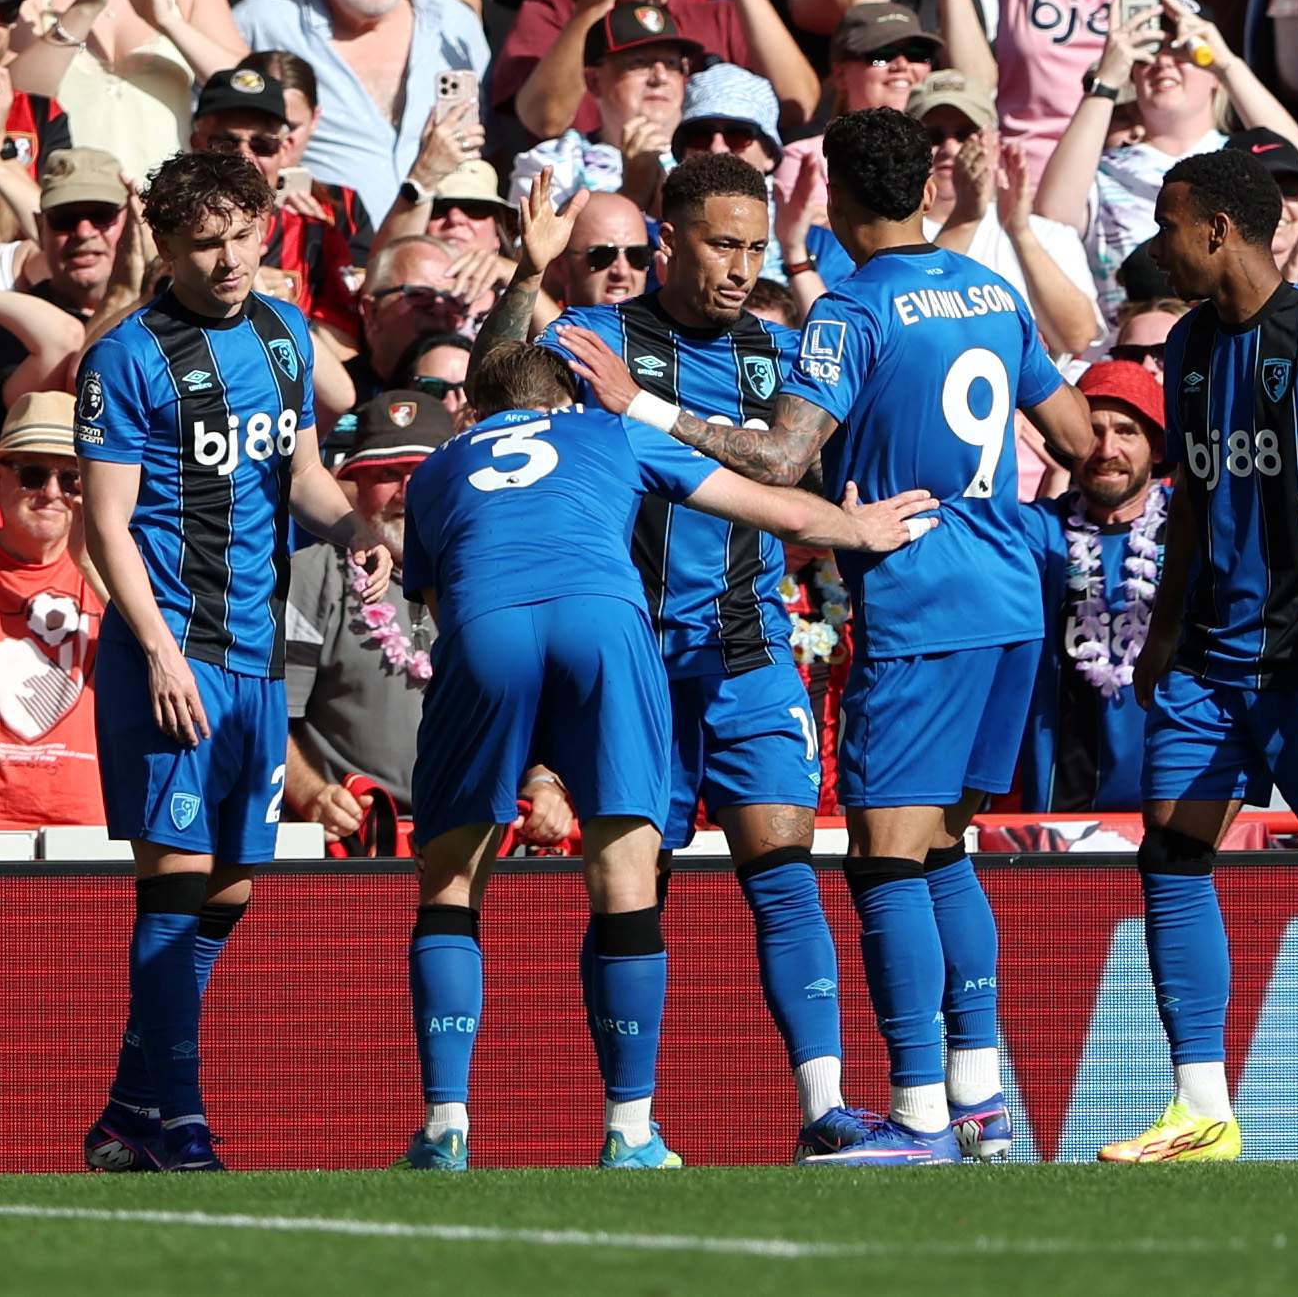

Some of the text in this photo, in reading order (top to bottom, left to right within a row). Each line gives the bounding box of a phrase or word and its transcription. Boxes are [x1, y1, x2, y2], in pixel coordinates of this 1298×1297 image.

[894, 284, 1016, 326] EVANILSON
[193, 409, 296, 475] bj88
[942, 348, 1008, 498] 9
[469, 419, 559, 492] 3
[1186, 429, 1283, 490] bj88
[789, 706, 819, 761] 1
[429, 1016, 475, 1037] AFCB
